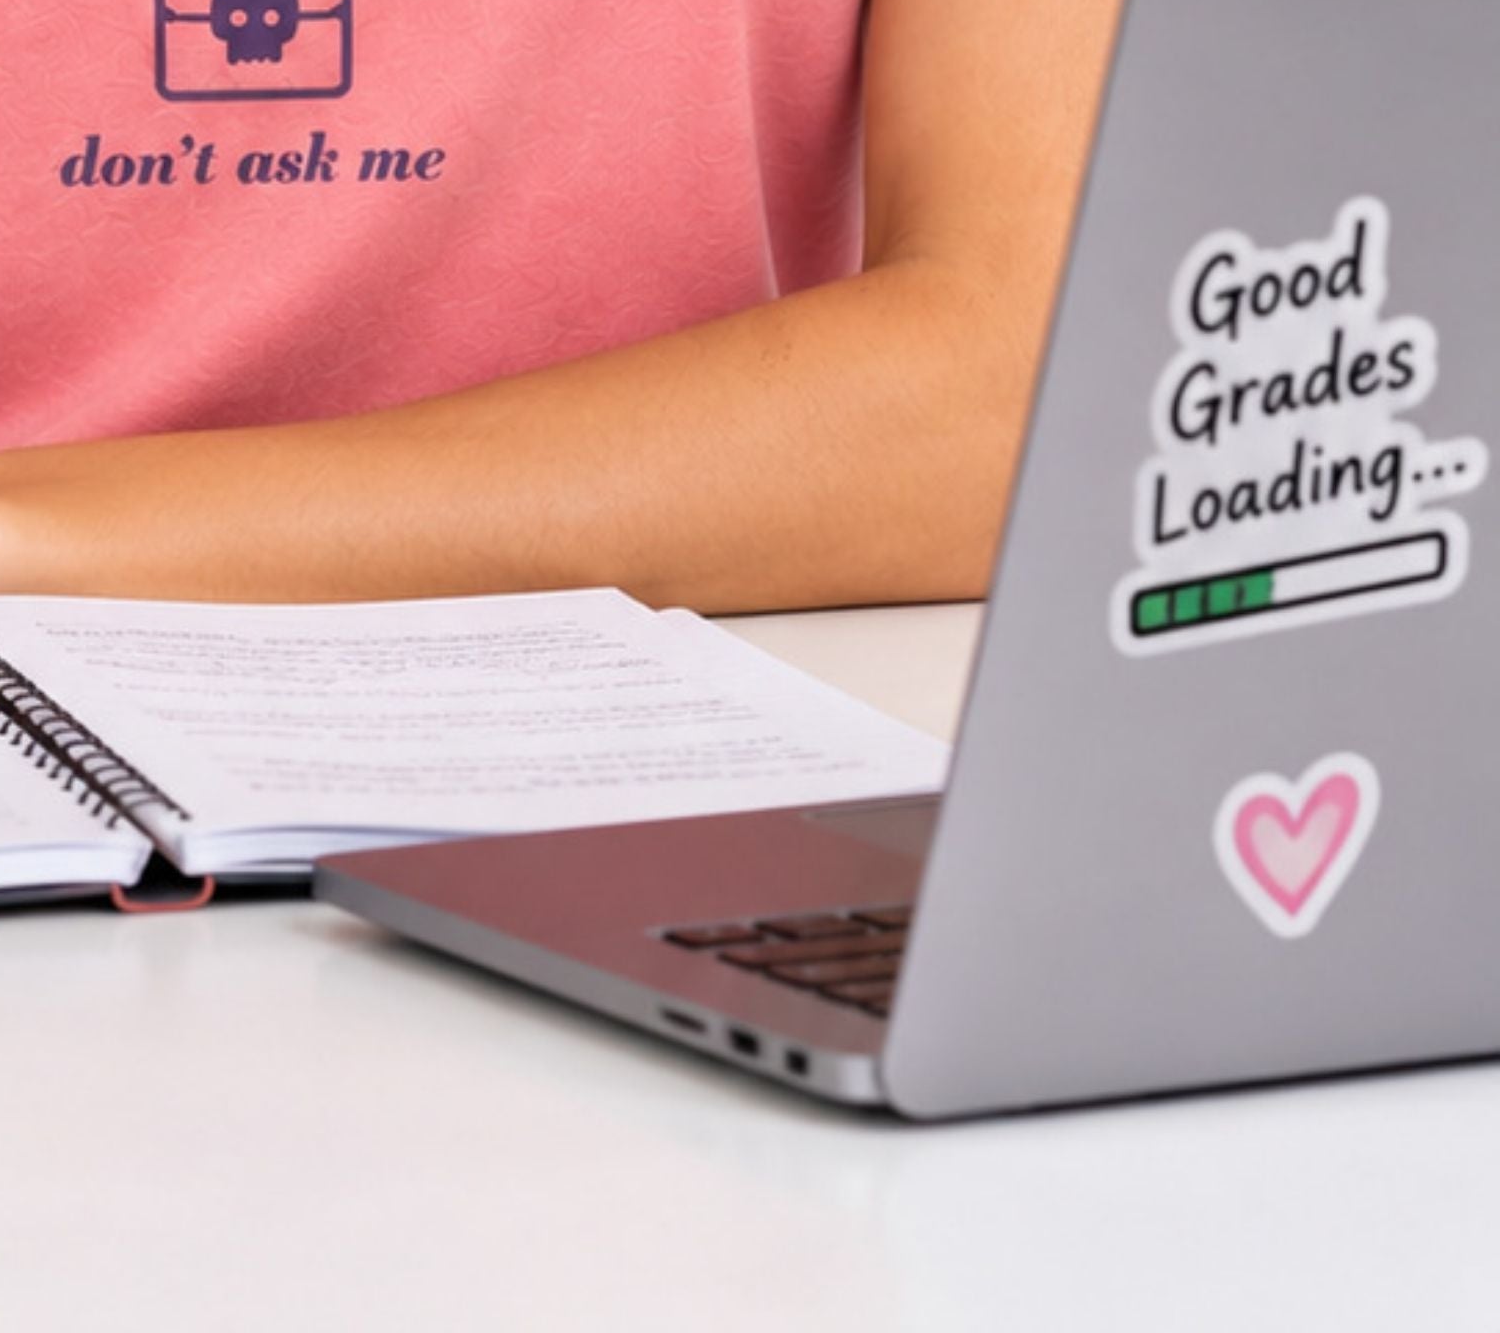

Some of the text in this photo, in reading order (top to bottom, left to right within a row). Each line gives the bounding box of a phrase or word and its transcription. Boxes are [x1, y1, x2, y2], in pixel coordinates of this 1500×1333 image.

[59, 129, 447, 188] don’t ask me
[1188, 218, 1367, 341] Good
[1169, 327, 1415, 446] Grades
[1151, 438, 1466, 547] Loading...
